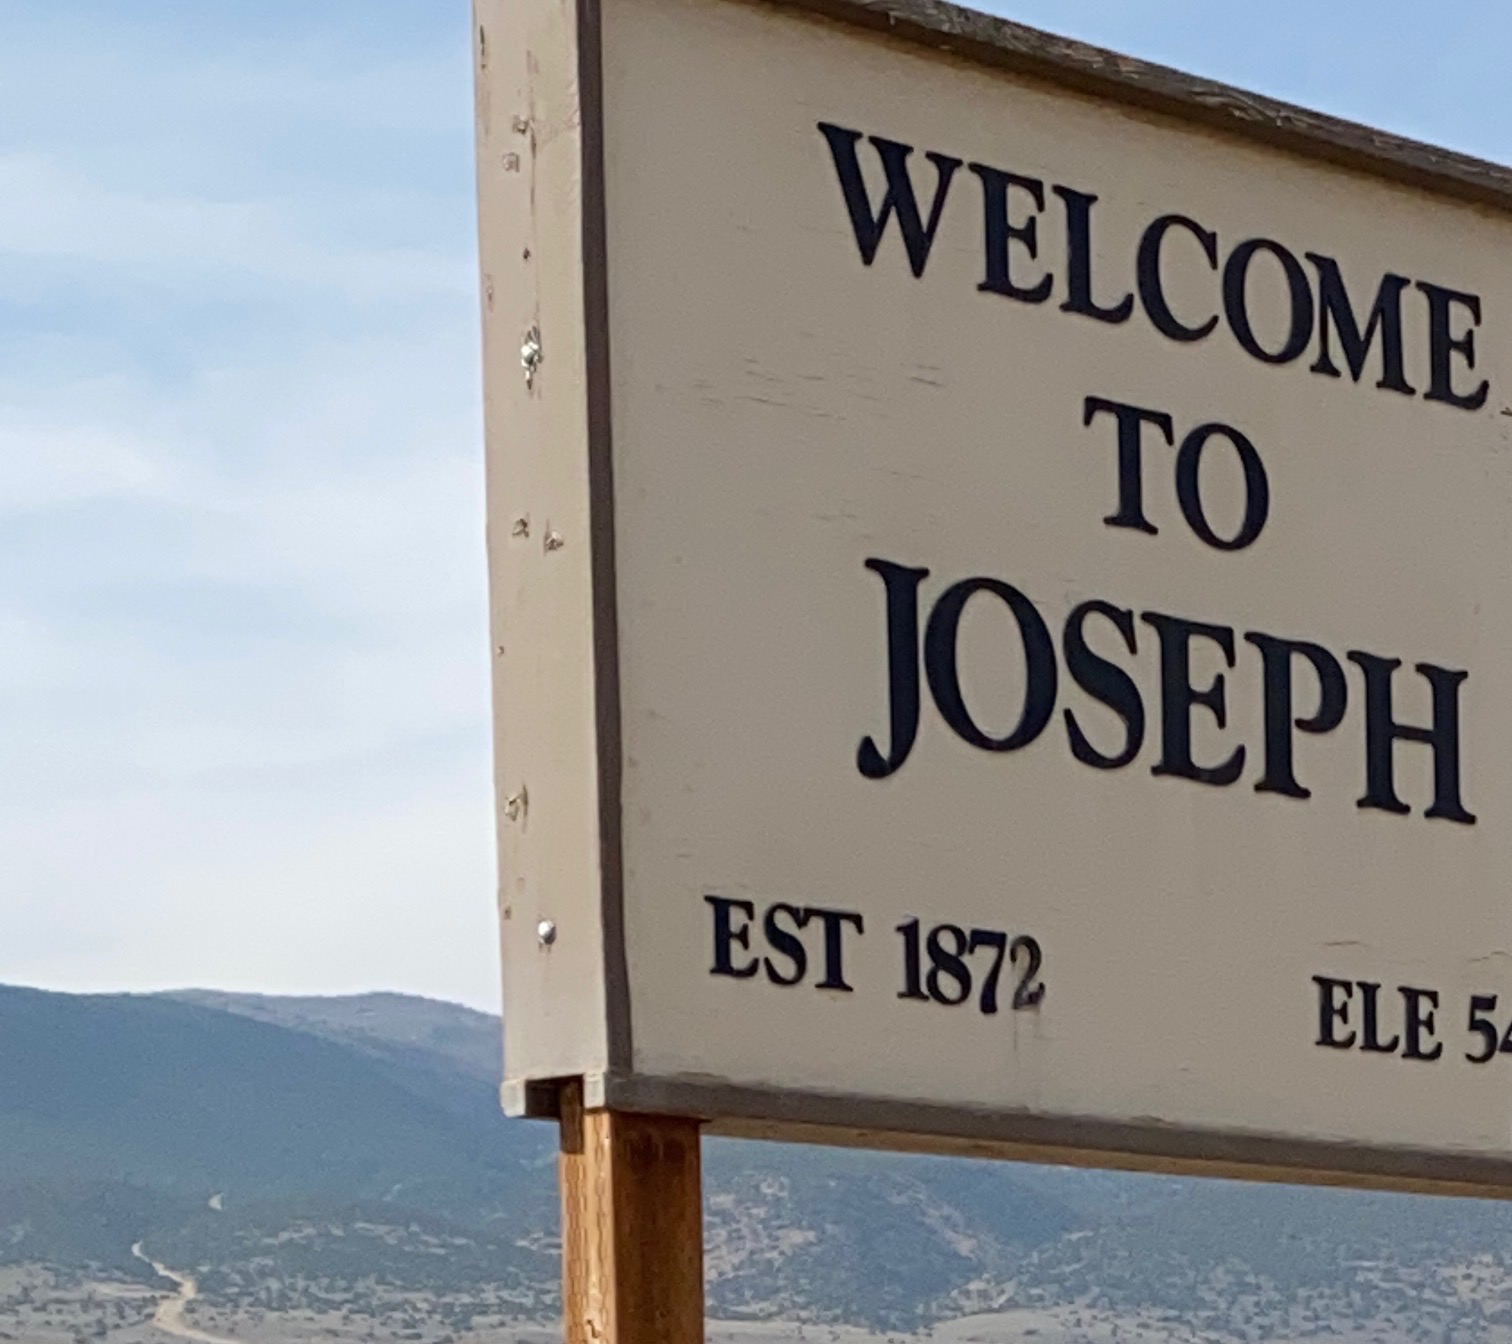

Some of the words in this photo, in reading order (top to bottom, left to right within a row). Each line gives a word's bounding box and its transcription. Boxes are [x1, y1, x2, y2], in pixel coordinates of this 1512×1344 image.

[816, 121, 1491, 412] WELCOME
[1083, 396, 1270, 553] TO
[856, 557, 1477, 826] JOSEPH
[703, 895, 864, 993] EST
[895, 915, 1046, 1016] 1872
[1311, 975, 1443, 1062] ELE
